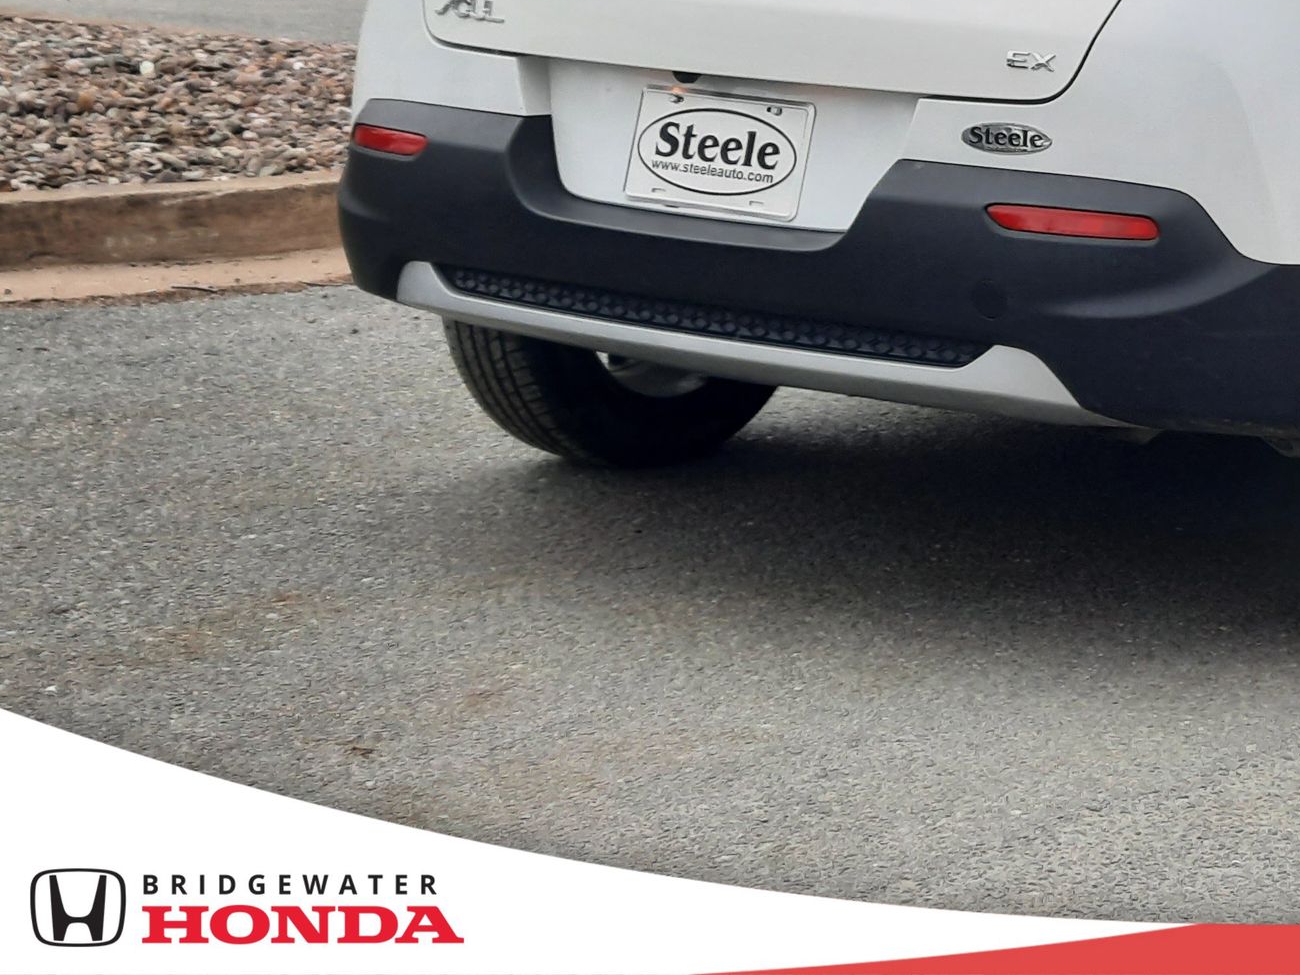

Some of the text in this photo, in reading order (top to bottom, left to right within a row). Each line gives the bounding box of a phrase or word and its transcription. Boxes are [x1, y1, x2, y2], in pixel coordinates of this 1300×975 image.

[1006, 50, 1057, 73] EX
[655, 121, 781, 171] Steele
[968, 125, 1045, 149] Steele
[651, 158, 775, 185] www.steeleauto.com
